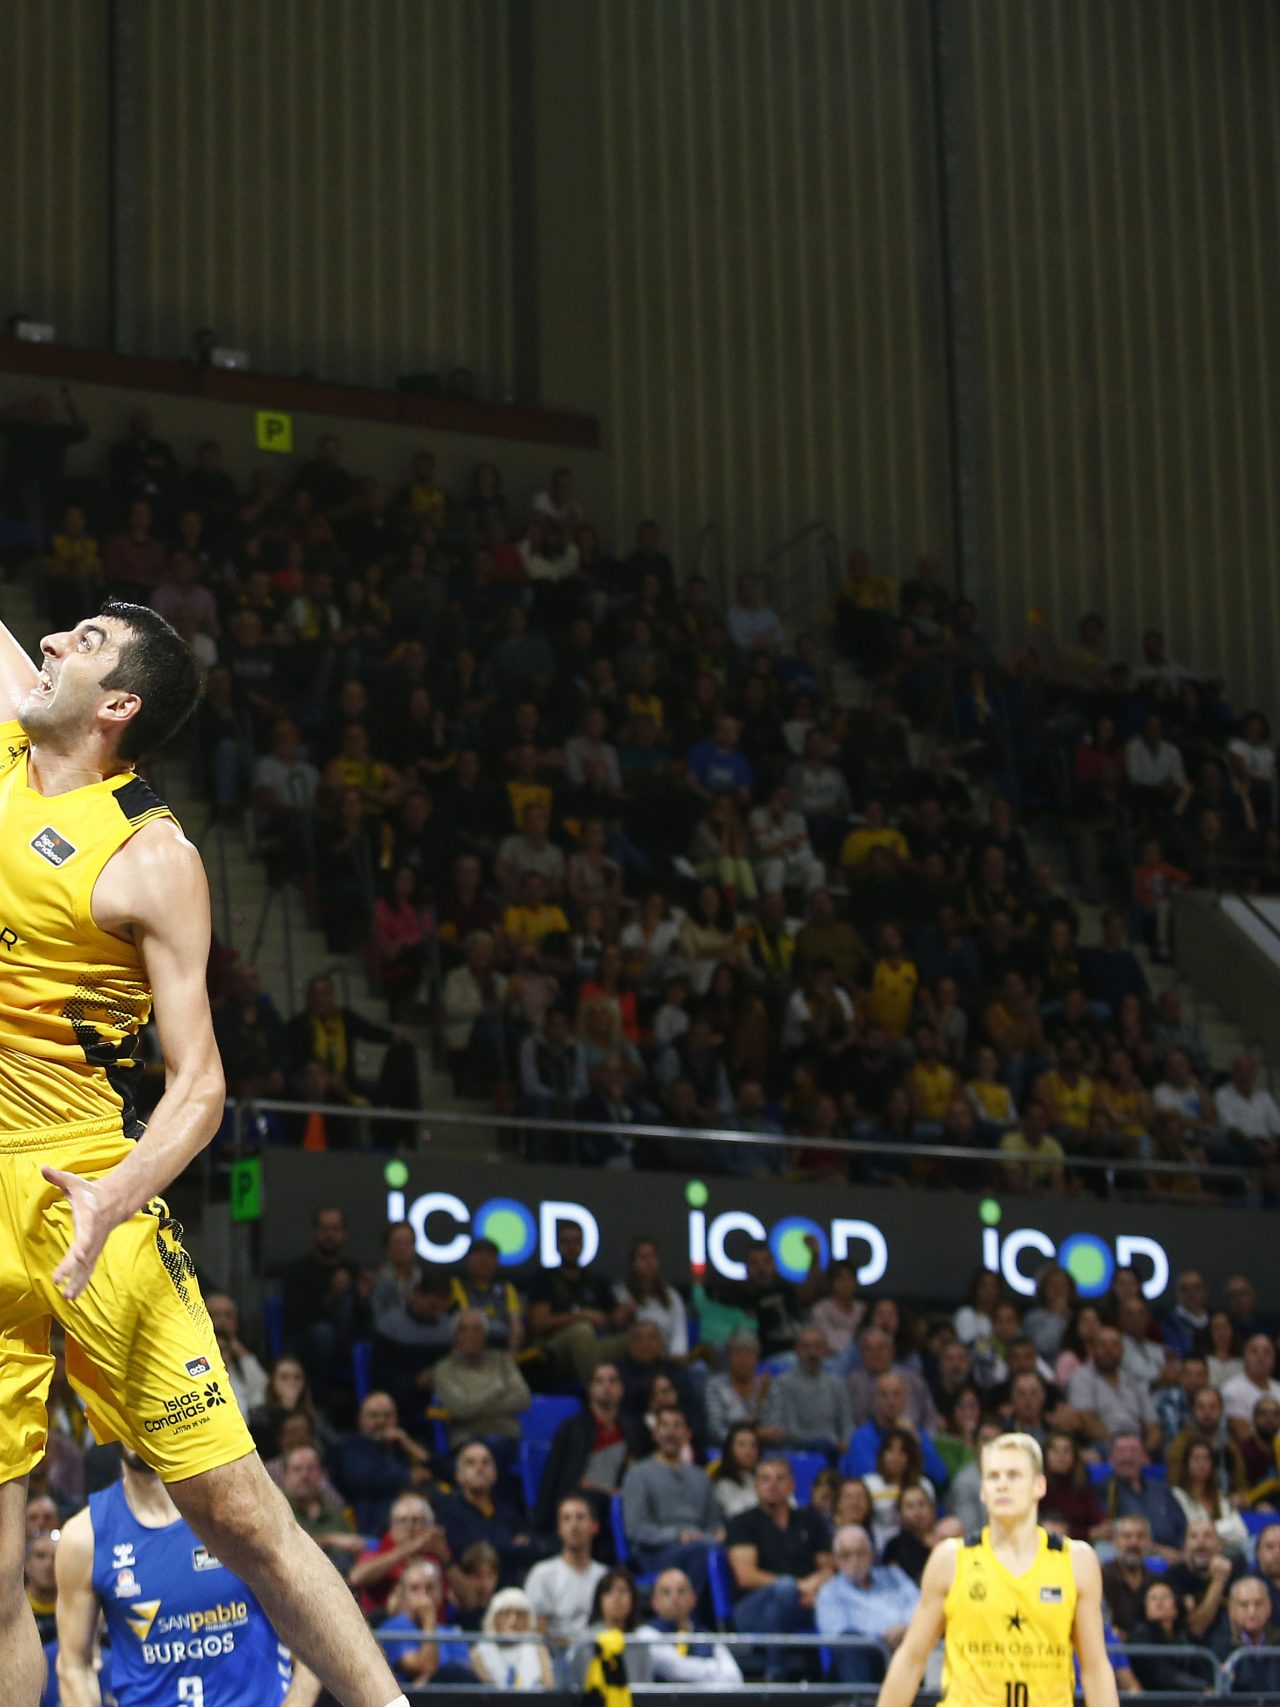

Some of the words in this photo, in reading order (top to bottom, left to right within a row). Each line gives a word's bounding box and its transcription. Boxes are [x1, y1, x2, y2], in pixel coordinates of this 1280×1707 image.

[35, 840, 63, 864] endesa
[189, 1364, 206, 1375] acb
[163, 1391, 200, 1413] Islas
[144, 1402, 206, 1433] Canarias
[142, 1631, 235, 1665] BURGOS
